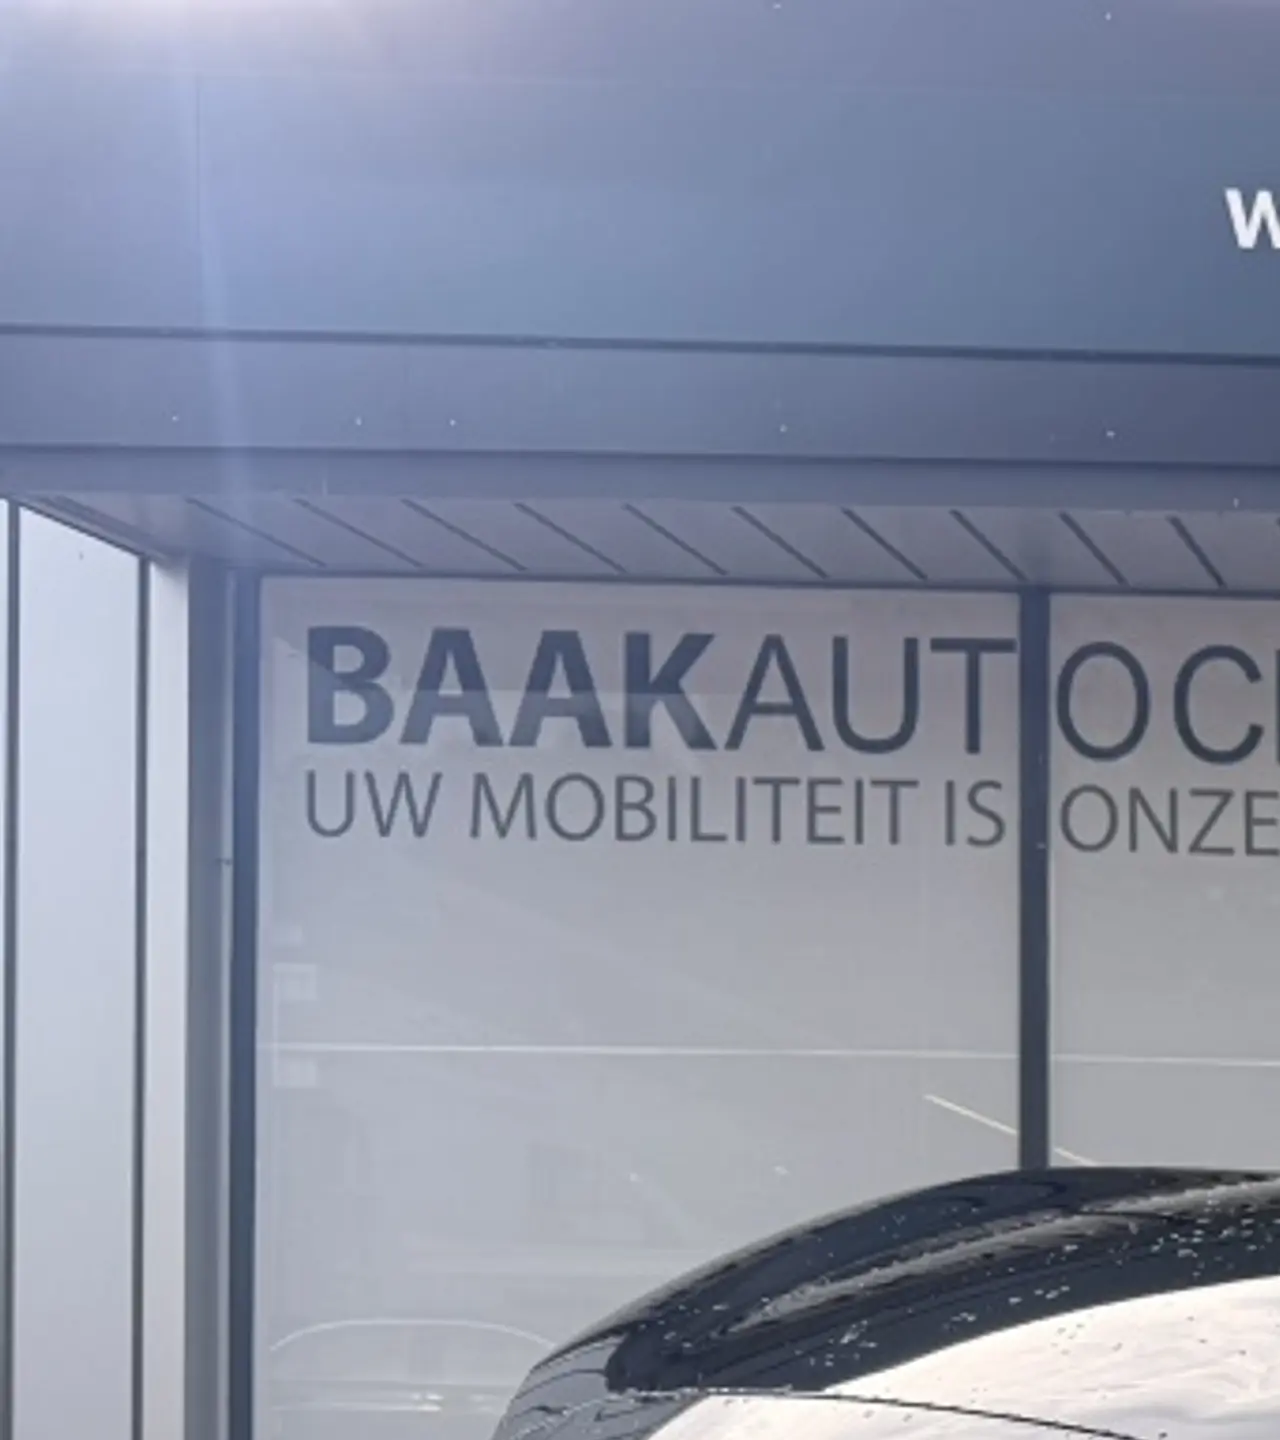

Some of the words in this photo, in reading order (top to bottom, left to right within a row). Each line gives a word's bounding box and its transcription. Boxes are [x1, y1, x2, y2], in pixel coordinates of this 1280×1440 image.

[305, 769, 443, 839] UW
[468, 772, 920, 846] MOBILITEIT
[944, 780, 1007, 847] IS
